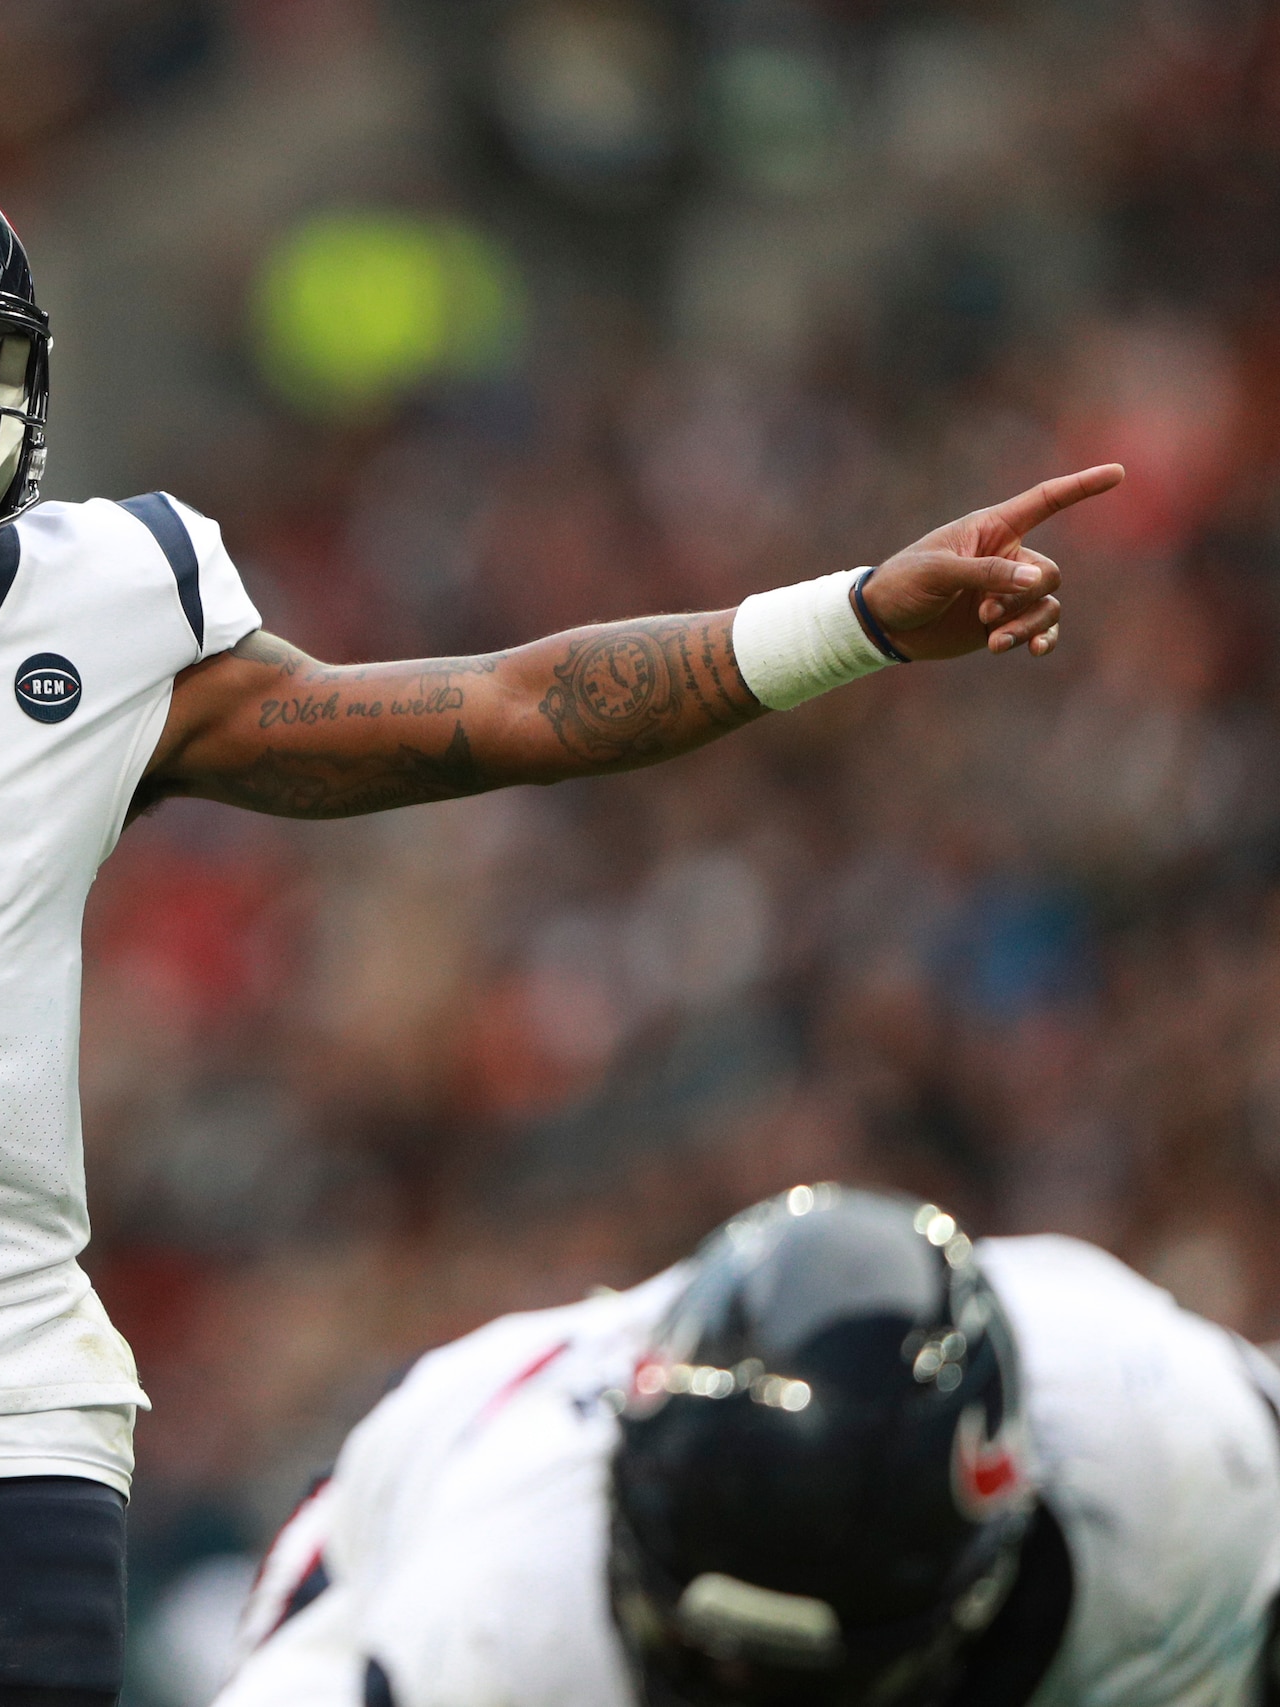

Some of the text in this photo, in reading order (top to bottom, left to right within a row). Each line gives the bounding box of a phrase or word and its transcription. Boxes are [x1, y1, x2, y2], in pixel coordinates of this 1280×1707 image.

[32, 678, 65, 695] RCM
[259, 691, 340, 729] Wish
[346, 700, 383, 718] me
